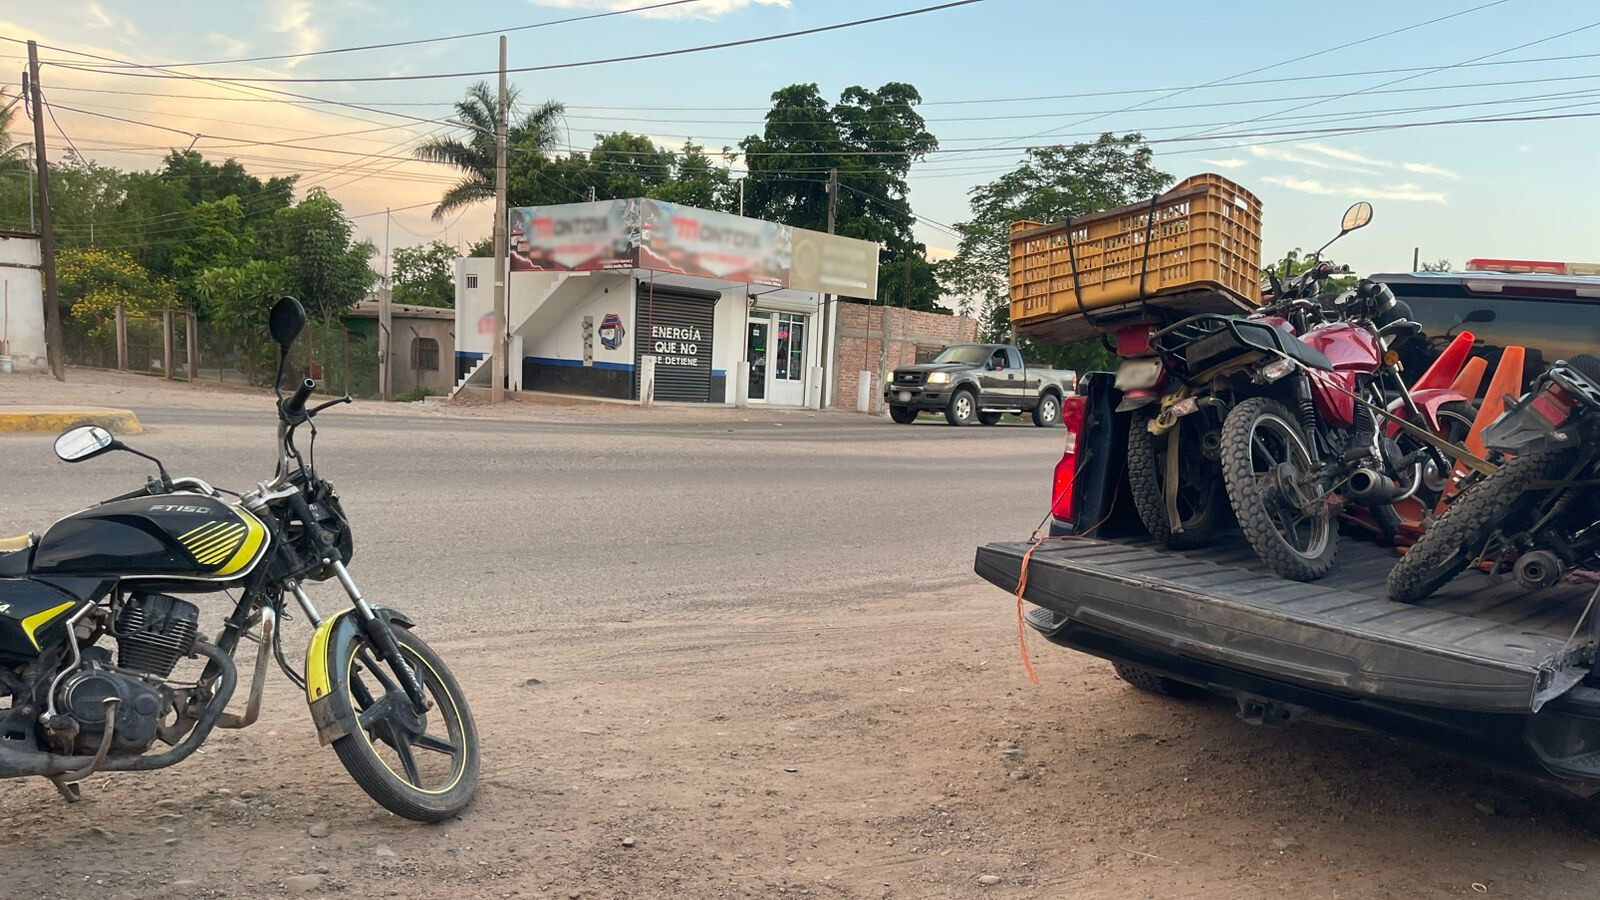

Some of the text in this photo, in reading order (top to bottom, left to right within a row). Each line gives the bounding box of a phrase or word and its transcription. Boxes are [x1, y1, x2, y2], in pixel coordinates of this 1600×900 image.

[652, 326, 701, 341] ENERGÍA
[655, 341, 698, 355] QUE NO
[665, 356, 699, 366] DETIENE
